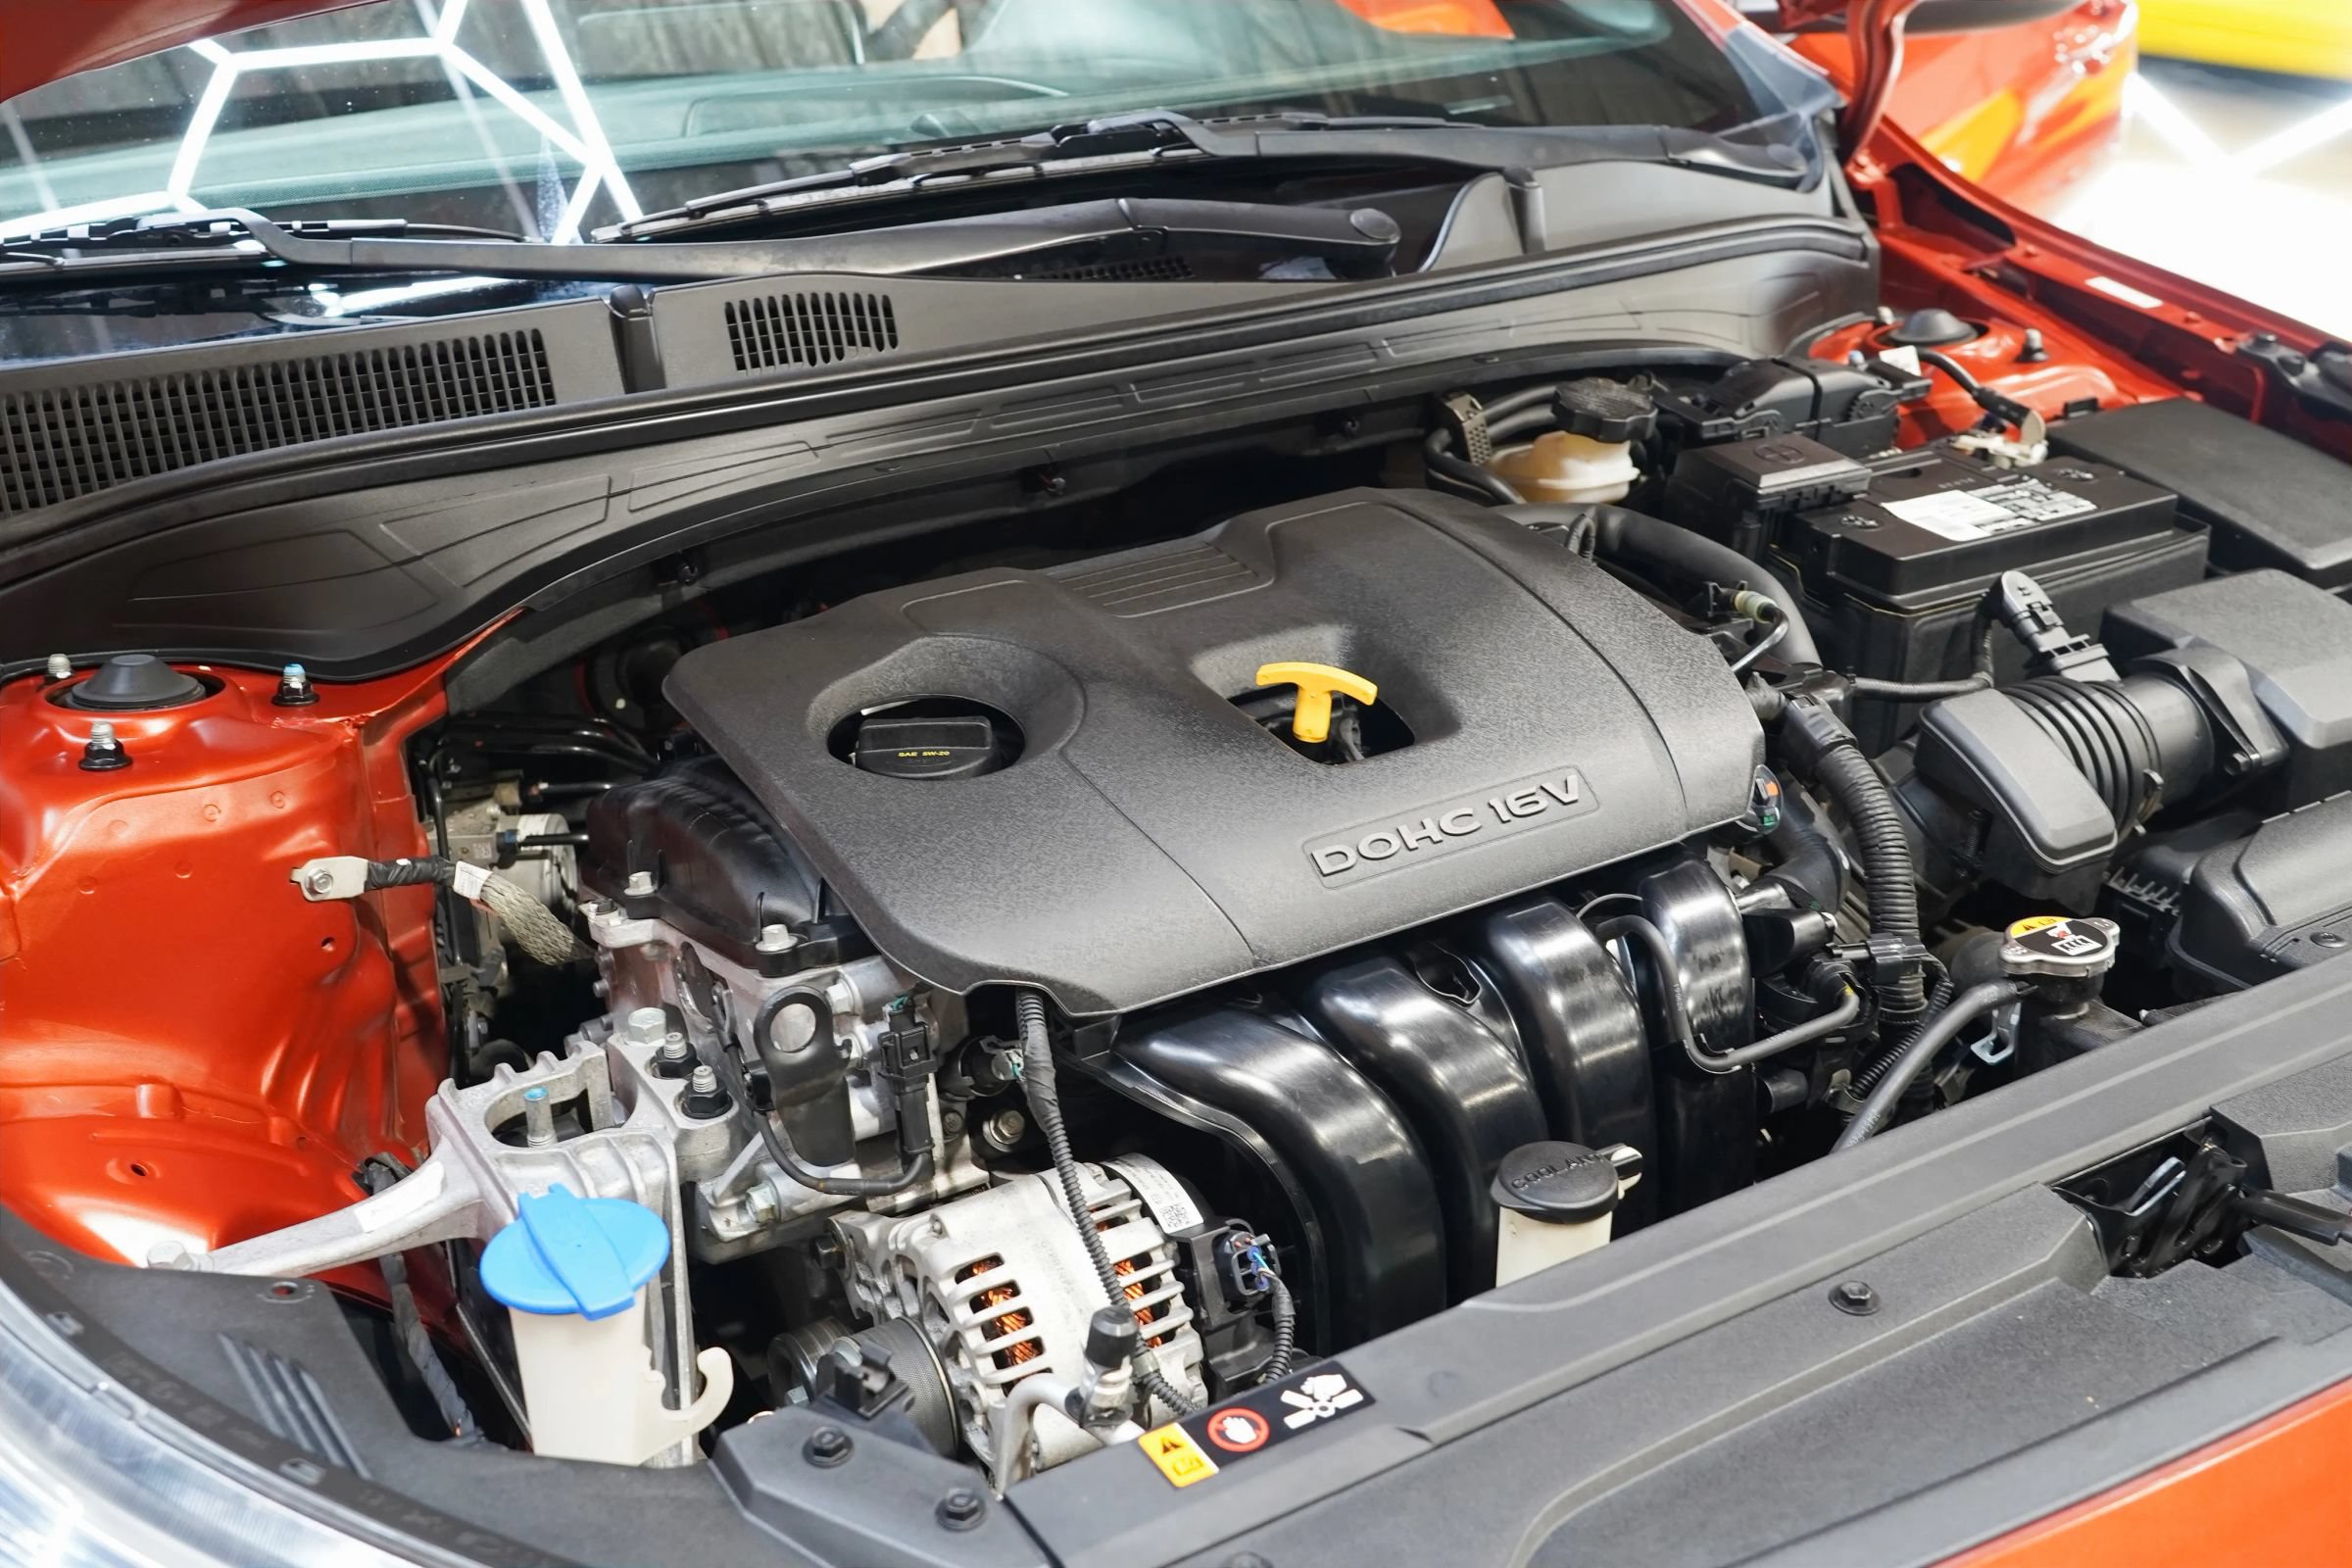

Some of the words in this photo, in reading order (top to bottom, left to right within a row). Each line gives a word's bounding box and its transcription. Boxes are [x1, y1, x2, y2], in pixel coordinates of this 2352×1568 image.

[1311, 808, 1482, 877] DOHC
[1489, 774, 1579, 824] 16V
[1511, 1153, 1605, 1190] COOLANT
